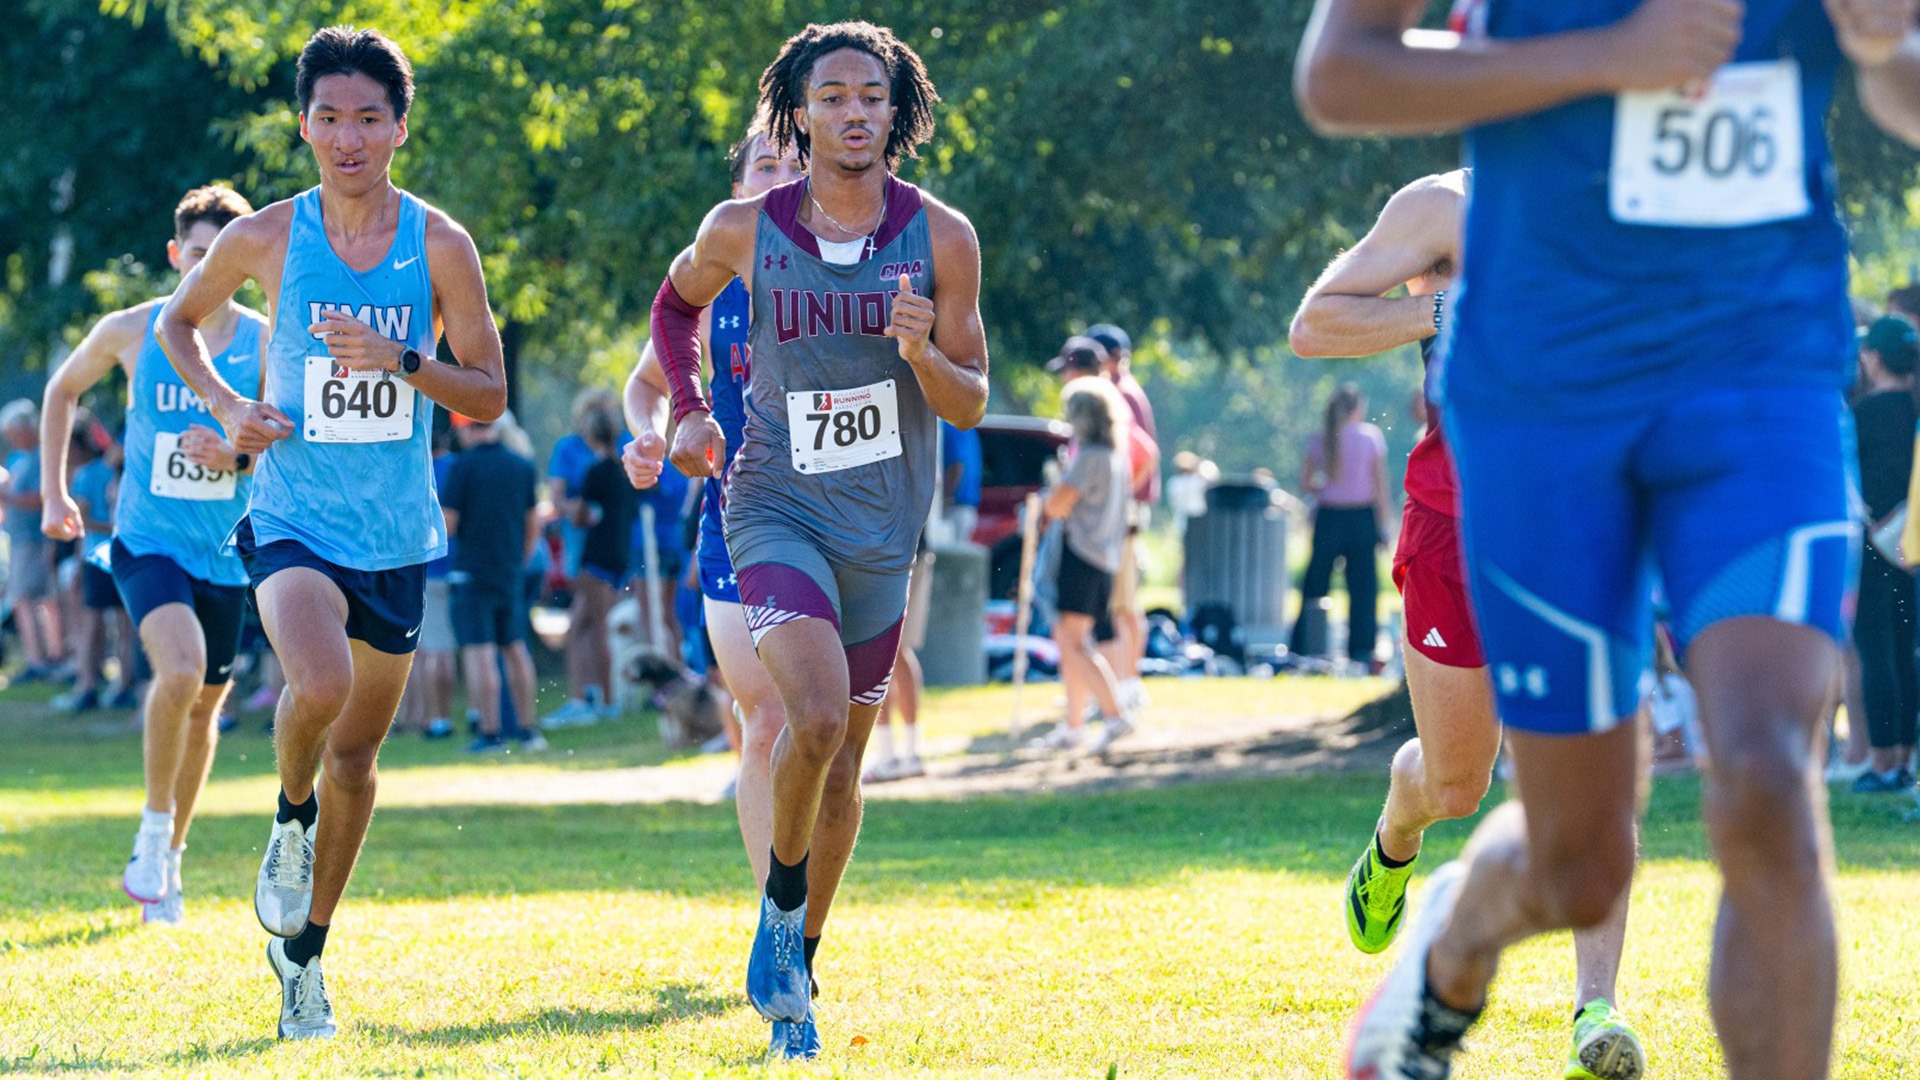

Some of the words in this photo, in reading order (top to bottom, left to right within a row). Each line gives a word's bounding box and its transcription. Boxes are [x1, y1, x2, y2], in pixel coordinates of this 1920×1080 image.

[1652, 104, 1775, 178] 506
[880, 259, 923, 281] CIAA
[771, 288, 920, 346] UNIO
[155, 382, 207, 412] UM
[322, 379, 397, 419] 640
[806, 404, 881, 451] 780
